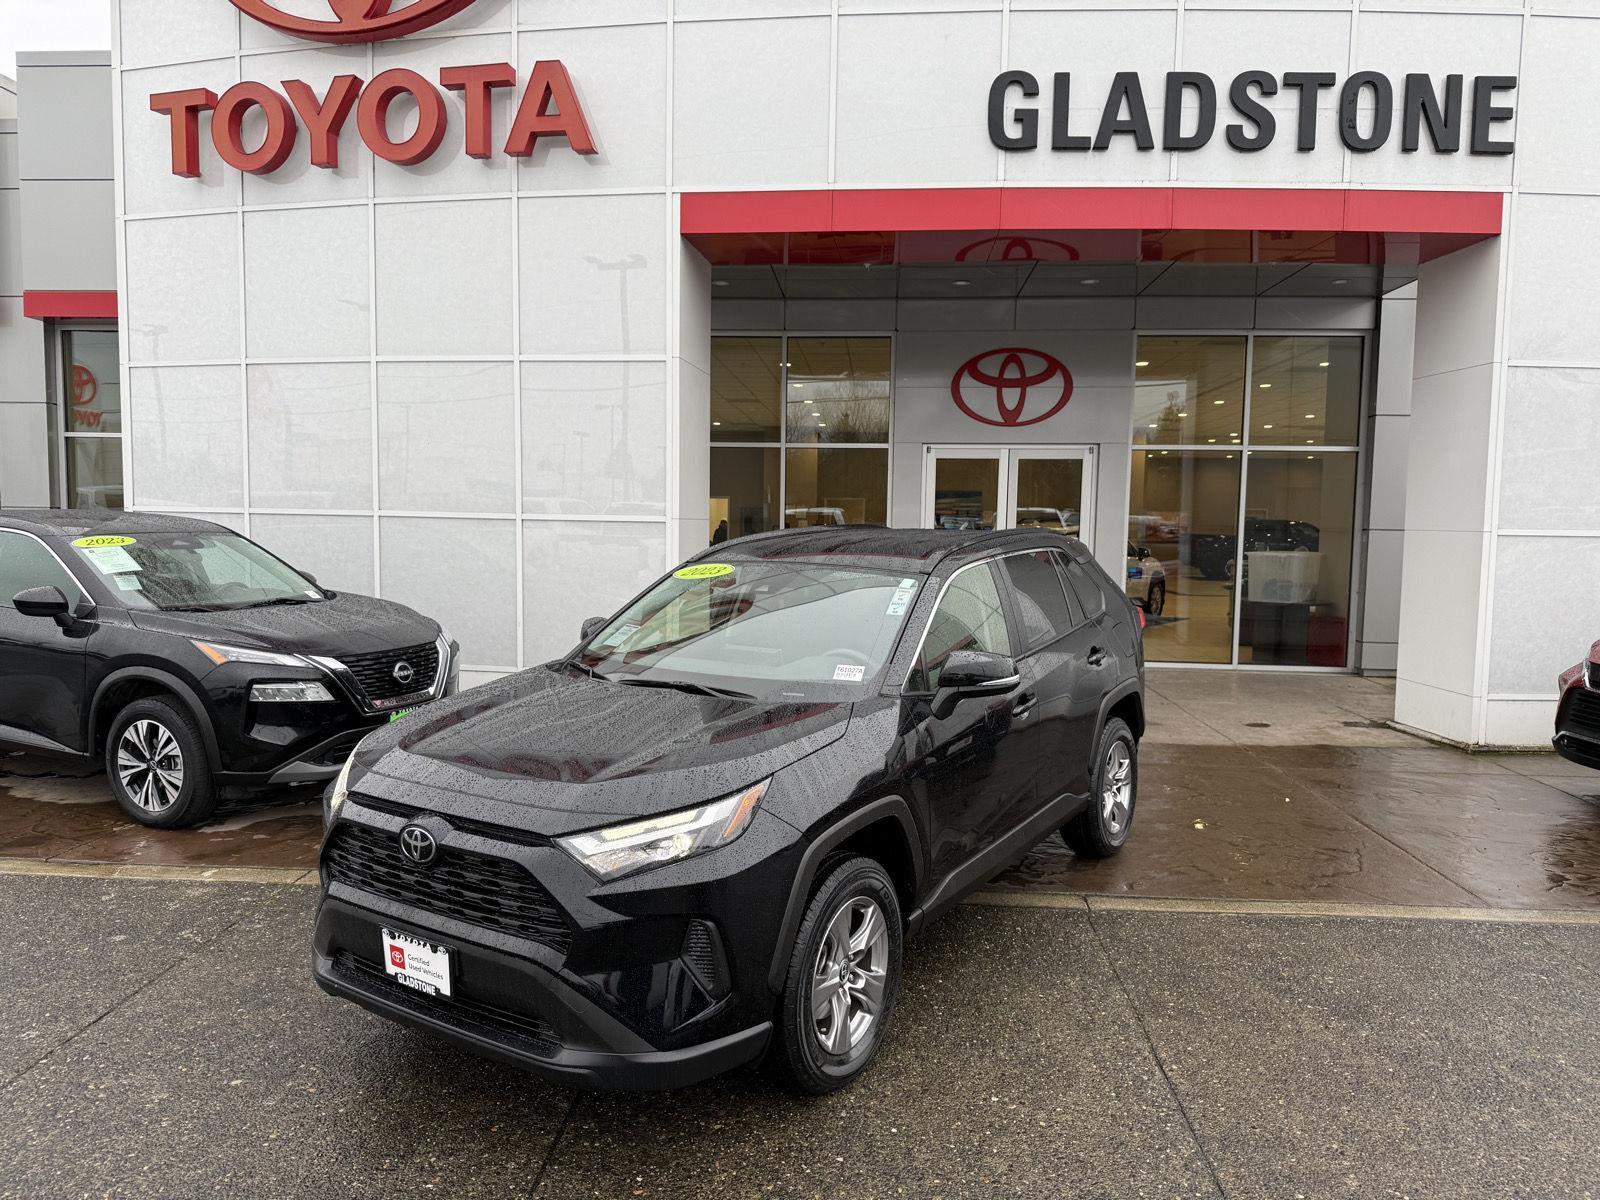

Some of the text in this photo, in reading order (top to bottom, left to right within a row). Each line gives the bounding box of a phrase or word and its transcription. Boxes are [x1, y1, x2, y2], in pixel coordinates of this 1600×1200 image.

[150, 59, 599, 178] TOYOTA
[987, 71, 1518, 154] GLADSTONE
[86, 537, 125, 546] 2023
[680, 566, 728, 577] 2023
[394, 932, 430, 948] TOYOTA
[407, 953, 430, 966] Certified
[408, 962, 444, 981] Used Vehicles
[397, 973, 436, 995] GLADSTONE
